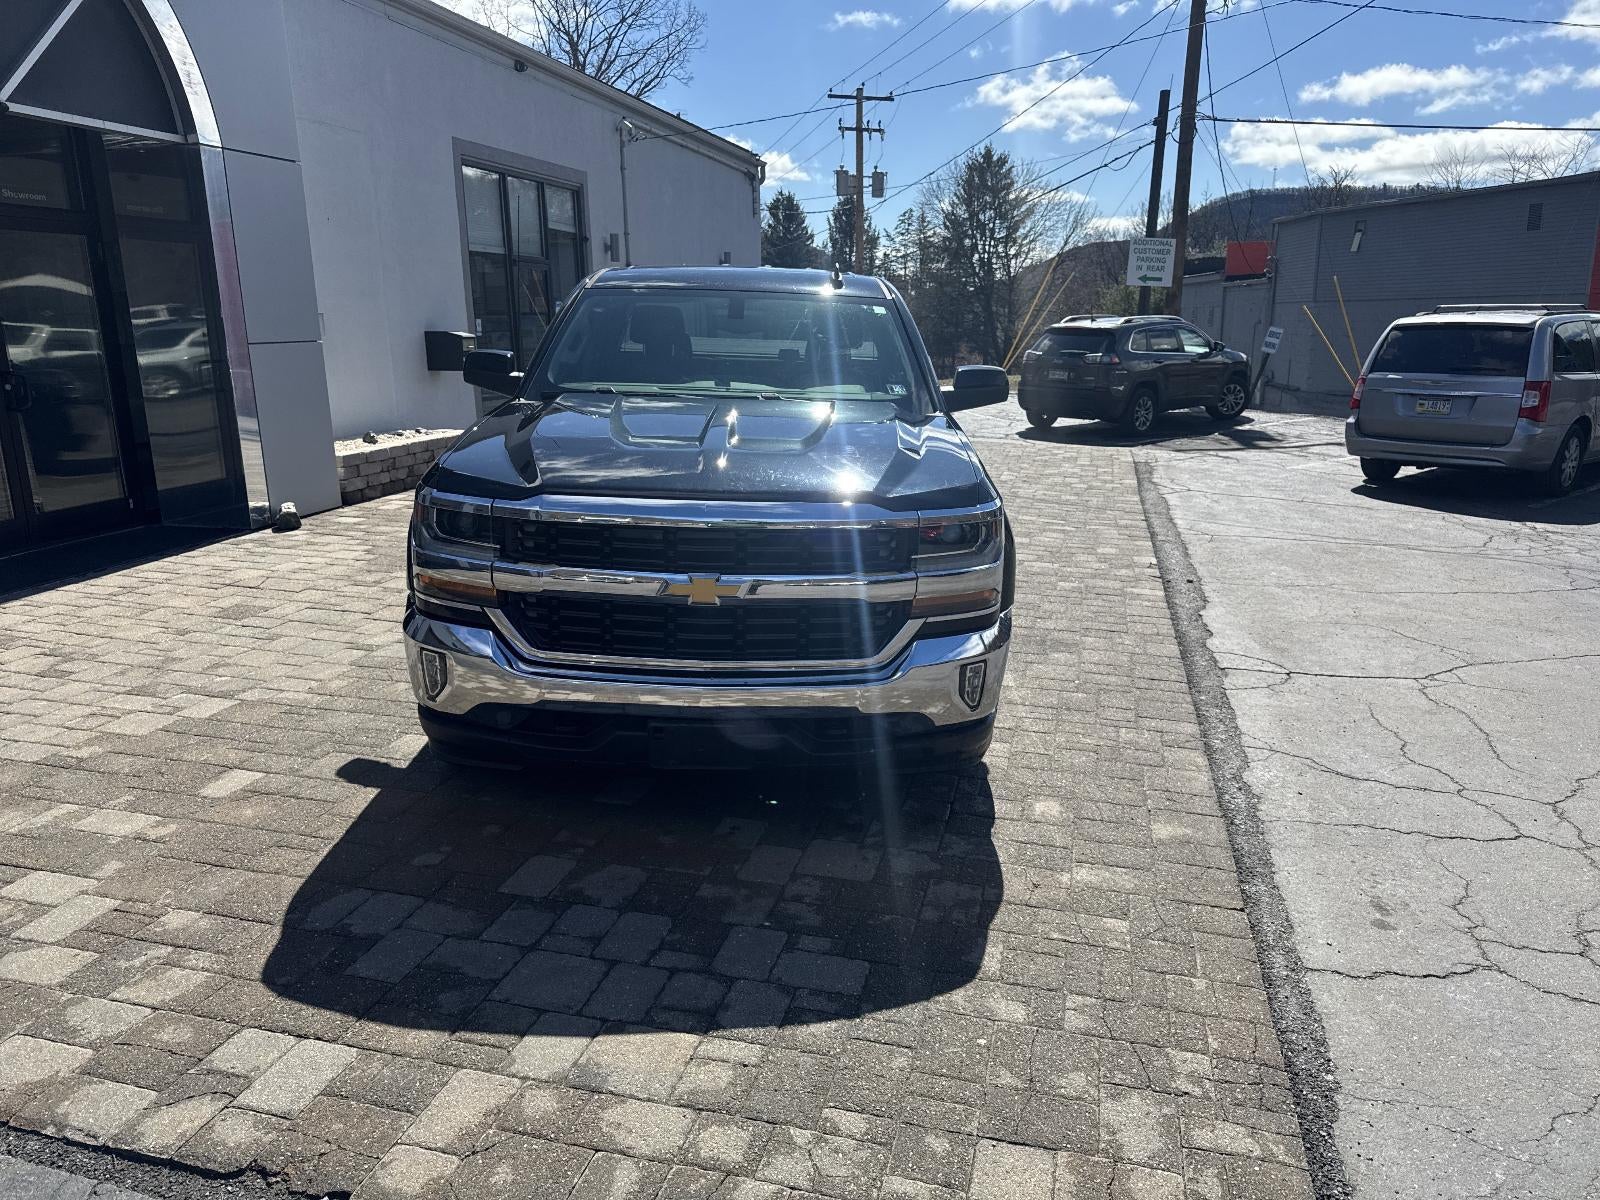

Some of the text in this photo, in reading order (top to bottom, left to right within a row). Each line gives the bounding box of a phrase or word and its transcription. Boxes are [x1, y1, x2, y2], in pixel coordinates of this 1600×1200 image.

[1, 189, 47, 200] Showroom
[1133, 239, 1173, 247] ADDITIONAL
[1133, 248, 1171, 256] CUSTOMER
[1136, 256, 1167, 264] PARKING
[1135, 264, 1166, 272] IN REAR
